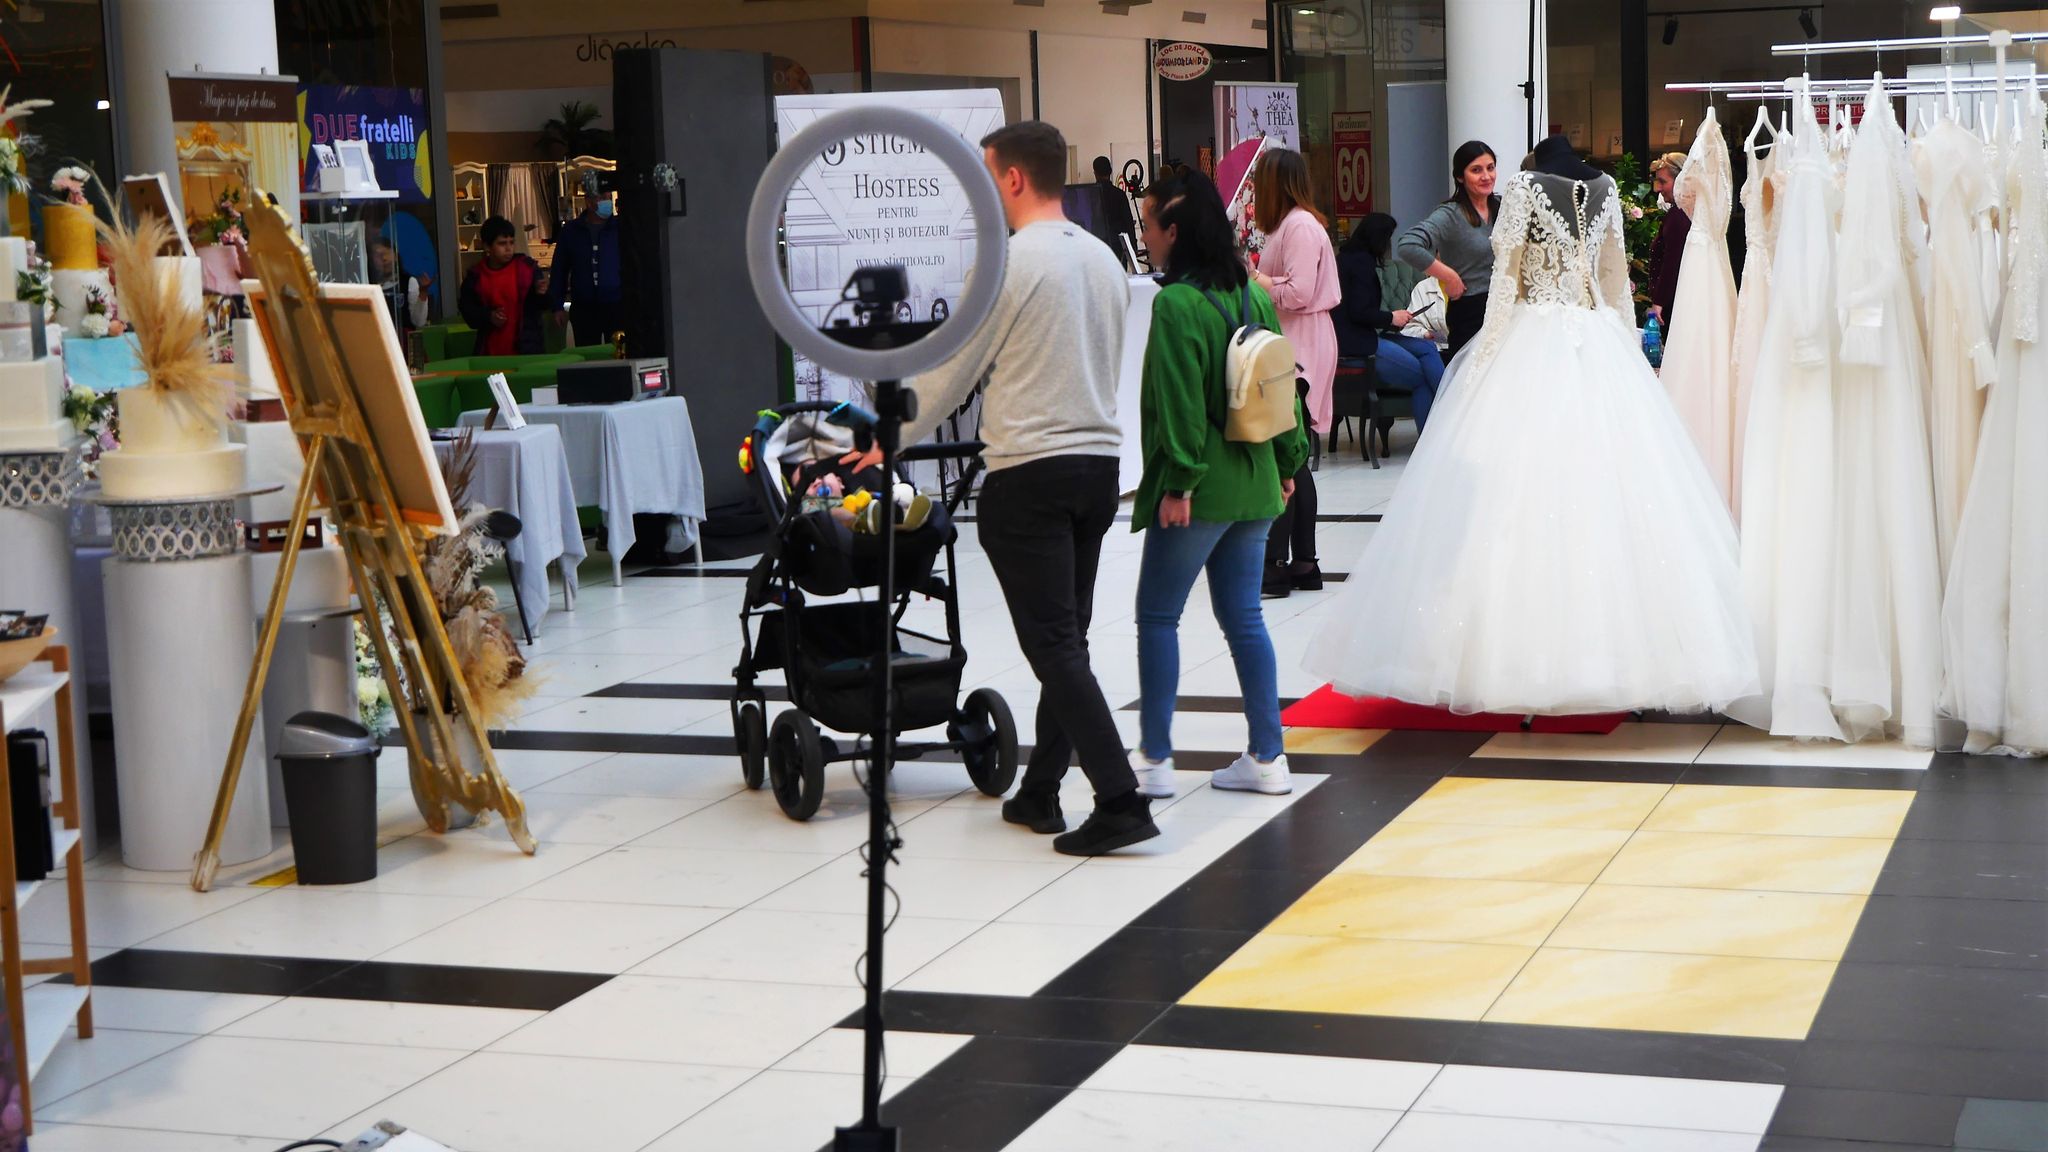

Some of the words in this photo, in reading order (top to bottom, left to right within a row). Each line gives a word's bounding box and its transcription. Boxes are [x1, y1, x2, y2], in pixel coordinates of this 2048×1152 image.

[1160, 47, 1173, 57] LOC
[1266, 111, 1294, 126] THEA
[313, 113, 359, 144] DUE
[360, 114, 415, 143] fratelli
[385, 142, 416, 160] KIDS
[1337, 147, 1370, 202] 60
[877, 206, 918, 220] PENTRU
[898, 225, 950, 239] BOTEZURI
